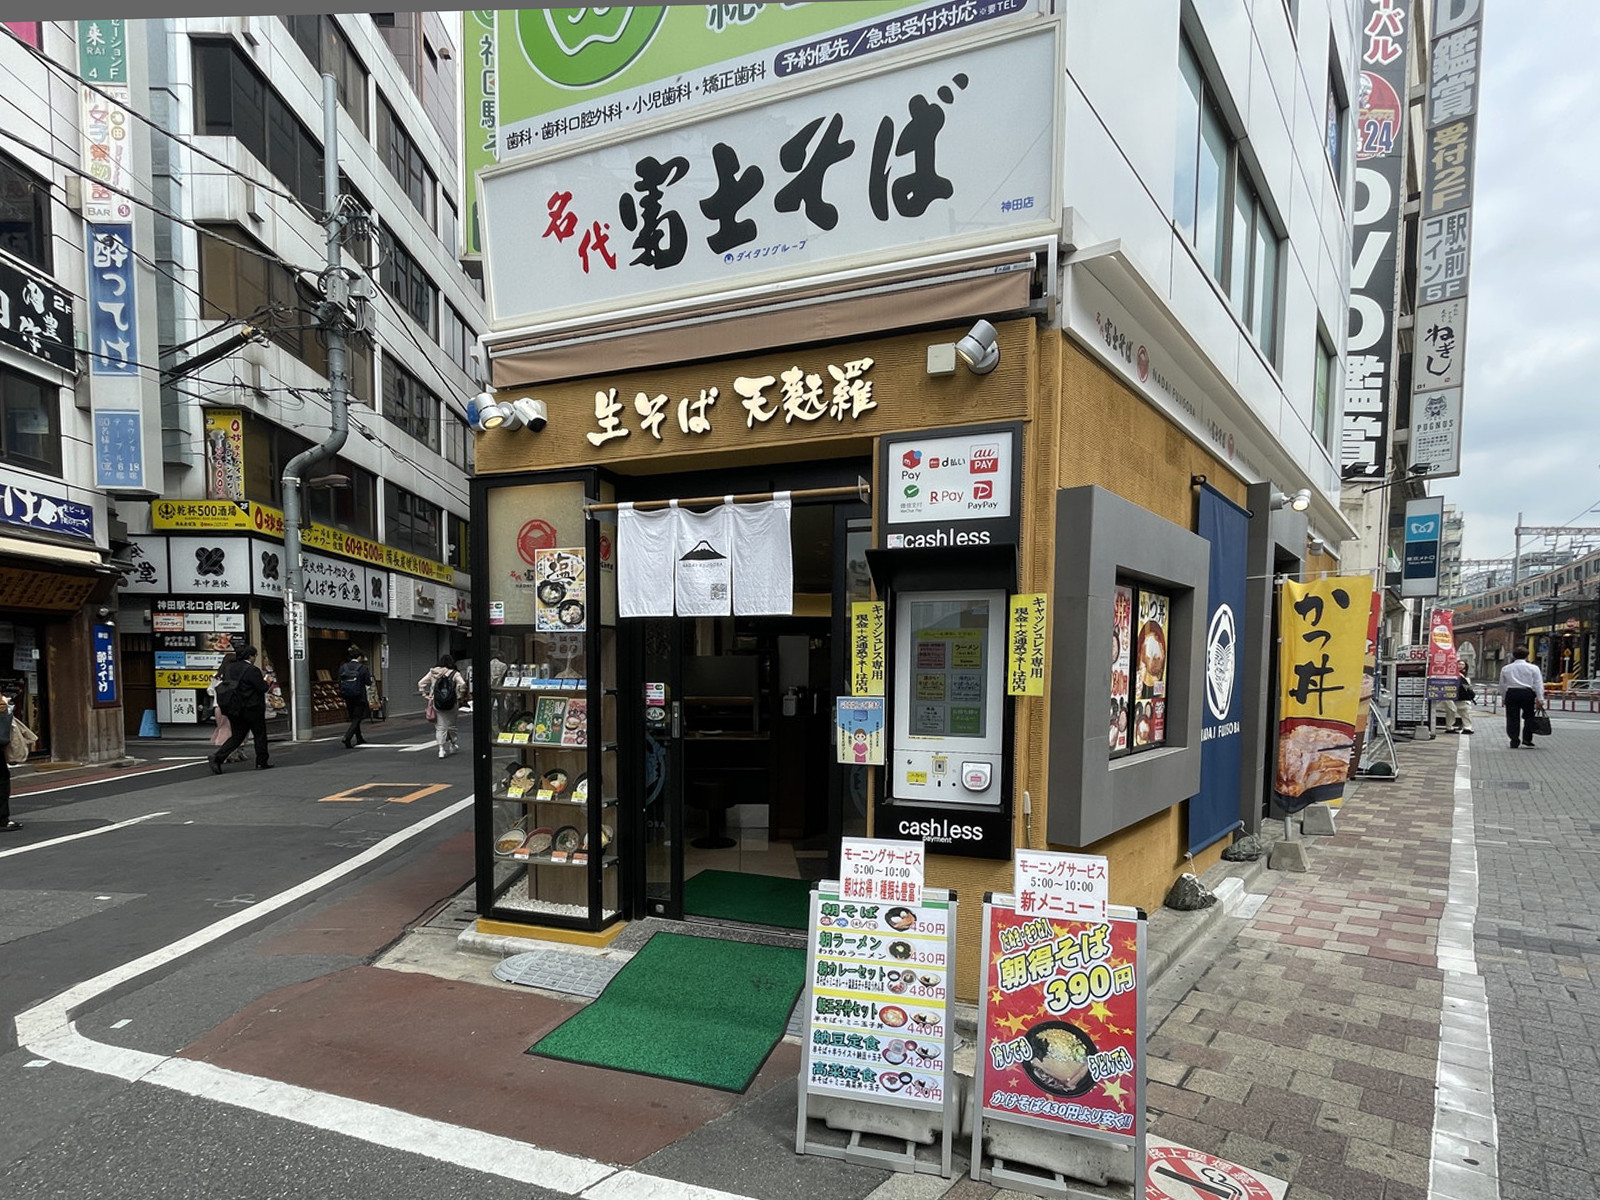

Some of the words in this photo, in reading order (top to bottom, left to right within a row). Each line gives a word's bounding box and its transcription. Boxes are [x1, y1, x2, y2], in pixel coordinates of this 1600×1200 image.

[1364, 120, 1394, 153] 24
[542, 191, 617, 274] 名代
[617, 72, 969, 271] 富士そば
[87, 207, 111, 217] BAR
[1000, 196, 1034, 213] 神田店
[736, 239, 808, 262] ダイタングループ
[1423, 221, 1443, 284] コイン
[1445, 211, 1468, 279] 駅前
[1426, 280, 1461, 301] 5F
[53, 295, 72, 315] 2F
[1424, 323, 1455, 376] ねぎし
[587, 387, 718, 447] 生そば
[1416, 419, 1454, 433] PUGNUS
[974, 448, 995, 458] au
[942, 457, 966, 468] d払い
[974, 459, 994, 470] PAY
[902, 470, 921, 481] Pay
[942, 490, 964, 502] Pay
[177, 505, 237, 517] 乾杯500酒場
[967, 500, 999, 510] PayPay
[903, 529, 991, 548] cashless
[157, 600, 240, 611] 神田駅北口合同ビル
[871, 604, 884, 681] キャッシュレス専用
[1029, 596, 1046, 679] キャッシュレス専用
[1289, 588, 1350, 715] かつ丼
[899, 818, 983, 841] cashless
[922, 835, 952, 844] payment
[844, 848, 921, 865] モーニングサービス
[853, 864, 910, 878] 5:00〜10:00
[1020, 859, 1106, 879] モーニングサービス
[1030, 876, 1094, 893] 5:00〜10:00
[820, 902, 880, 919] 朝そば
[1020, 889, 1106, 918] 新メニュー!
[910, 922, 945, 935] 450円
[818, 931, 882, 951] 朝ラーメン
[818, 947, 887, 960] わかめラーメン
[910, 952, 945, 965] 430円
[1000, 923, 1111, 991] 朝得そば
[816, 960, 886, 982] 朝カレーセット
[909, 985, 946, 999] 480円
[1047, 964, 1135, 1013] 390円
[907, 1023, 943, 1038] 440円
[813, 1029, 880, 1052] 納豆定食
[906, 1056, 943, 1071] 420円
[812, 1061, 878, 1084] 高菜定食
[905, 1086, 942, 1101] 420円
